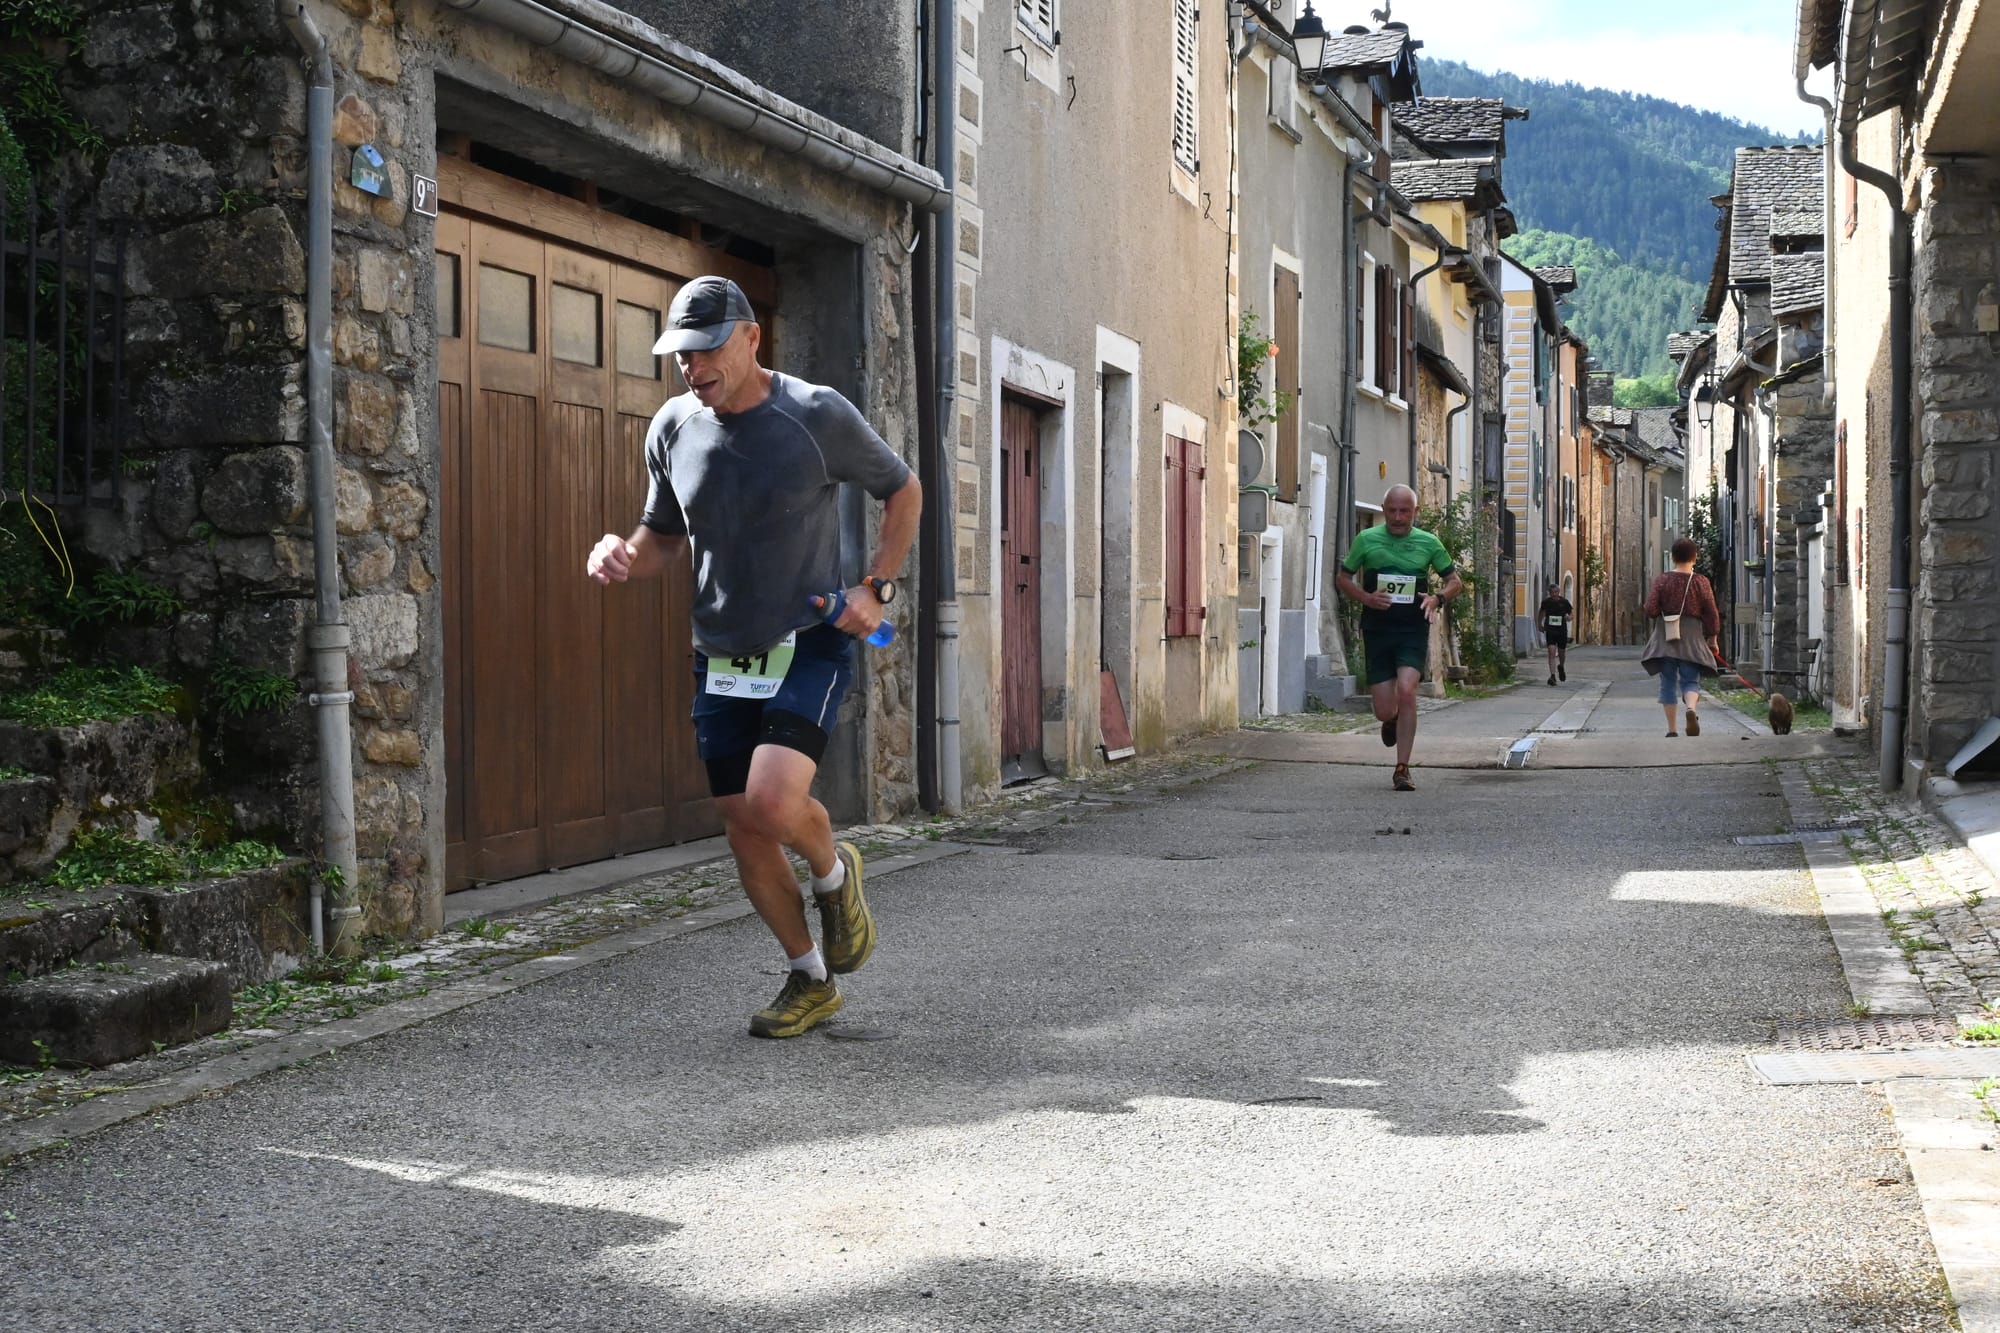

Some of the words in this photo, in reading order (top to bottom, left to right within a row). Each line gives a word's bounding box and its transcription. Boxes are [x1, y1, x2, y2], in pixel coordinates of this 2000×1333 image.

[417, 179, 426, 208] 9
[1387, 582, 1406, 594] 97
[731, 652, 768, 675] 41
